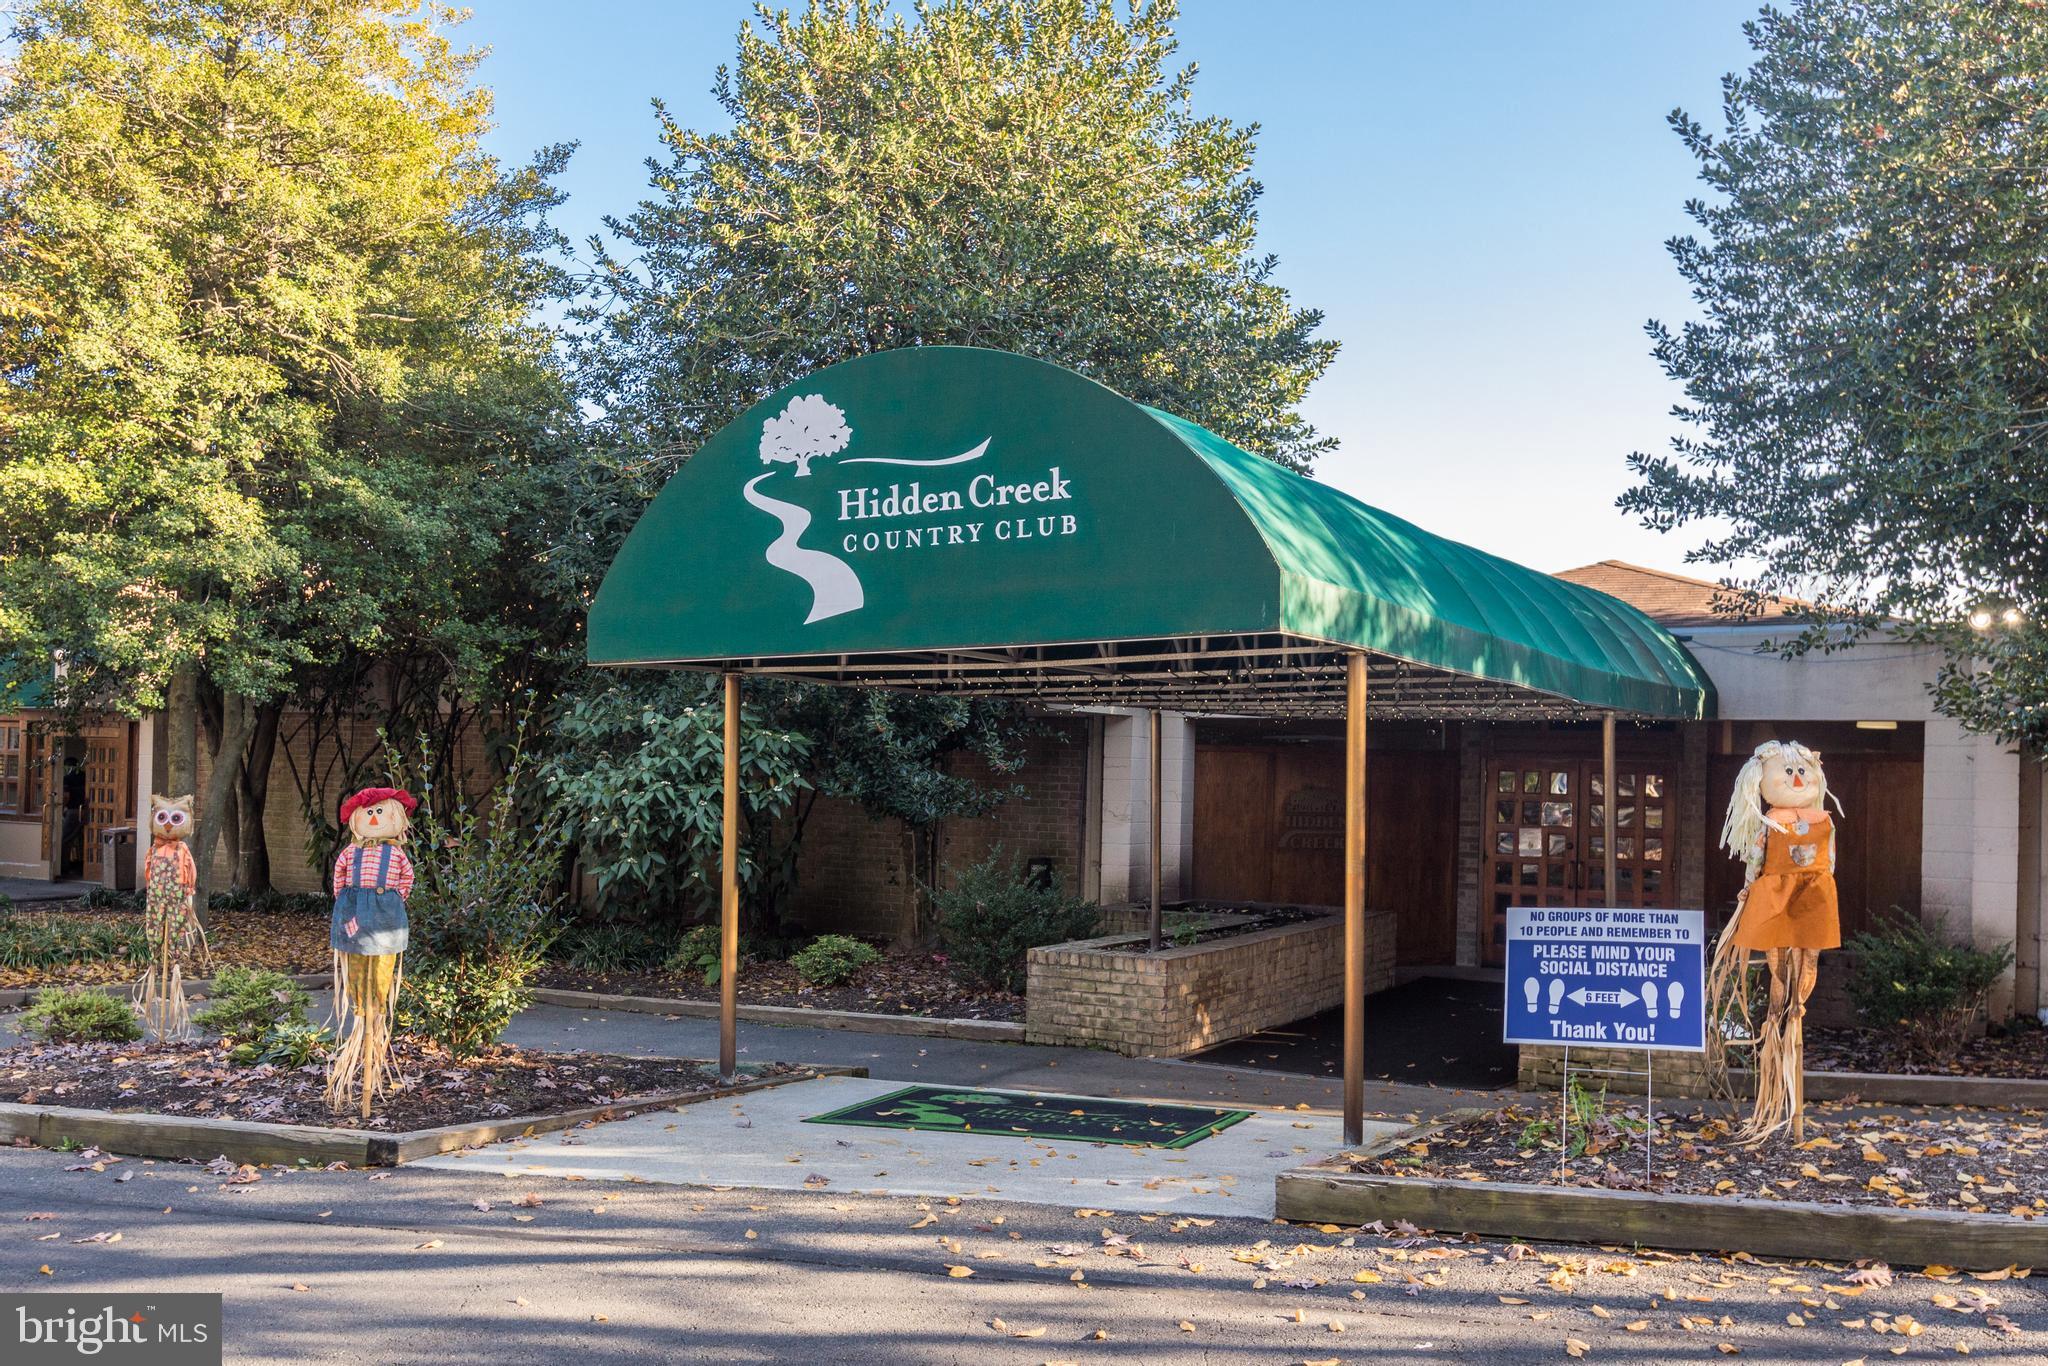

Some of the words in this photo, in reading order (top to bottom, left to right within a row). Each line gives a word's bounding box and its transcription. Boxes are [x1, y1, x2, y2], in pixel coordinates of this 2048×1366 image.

[837, 481, 964, 521] Hidden
[968, 466, 1072, 508] Creek
[843, 522, 984, 553] COUNTRY
[995, 514, 1077, 541] CLUB
[1530, 911, 1545, 922] NO
[1548, 912, 1592, 923] GROUPS
[1595, 912, 1609, 923] OF
[1612, 912, 1646, 923] MORE
[1648, 913, 1679, 924] THAN
[1520, 926, 1533, 936] 10
[1536, 926, 1577, 937] PEOPLE
[1581, 927, 1603, 937] AND
[1606, 927, 1672, 939] REMEMBER
[1675, 929, 1690, 940] TO
[1533, 944, 1587, 959] PLEASE
[1591, 945, 1630, 960] MIND
[1635, 946, 1676, 961] YOUR
[1540, 960, 1592, 975] SOCIAL
[1595, 961, 1668, 978] DISTANCE
[1585, 993, 1592, 1002] 6
[1595, 993, 1620, 1003] FEET
[1550, 1020, 1607, 1040] Thank
[1613, 1022, 1656, 1041] You!
[1091, 1117, 1183, 1129] Crek
